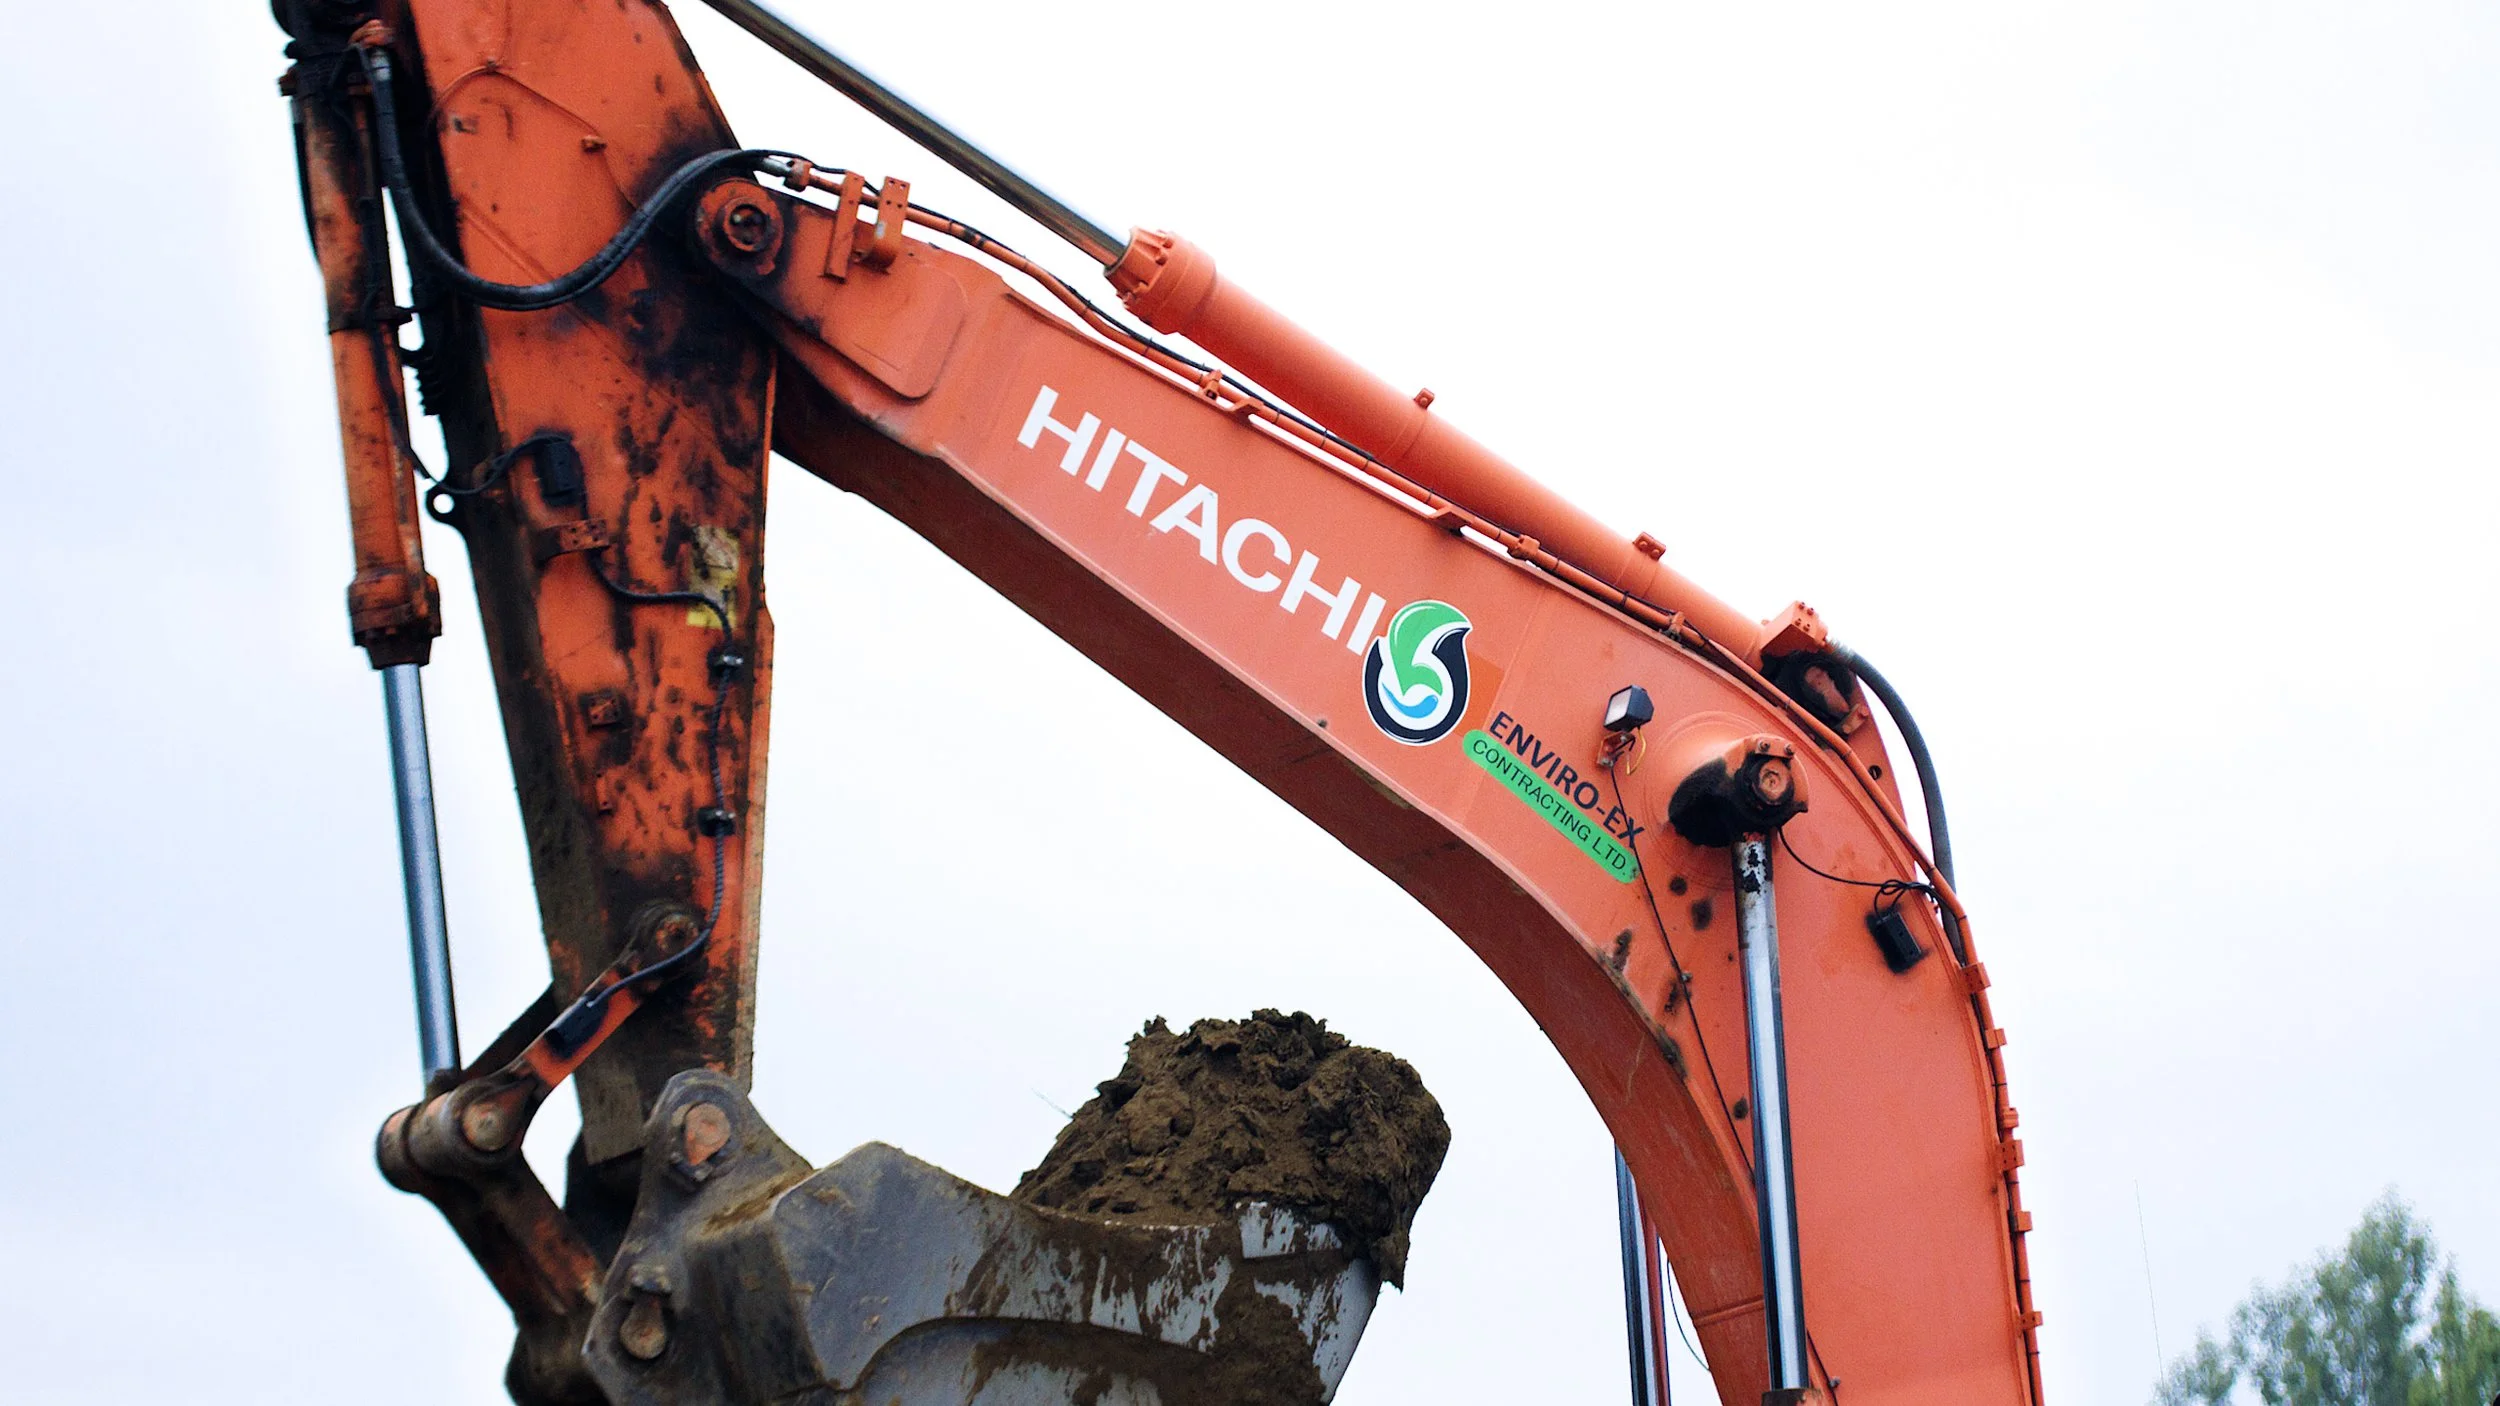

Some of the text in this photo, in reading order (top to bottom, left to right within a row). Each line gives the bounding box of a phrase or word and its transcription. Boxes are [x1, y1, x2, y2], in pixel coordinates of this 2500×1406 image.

[1017, 385, 1387, 656] HITACHI
[1473, 739, 1627, 876] CONTRACTING LTD.
[1489, 711, 1645, 848] ENVIRO-EX
